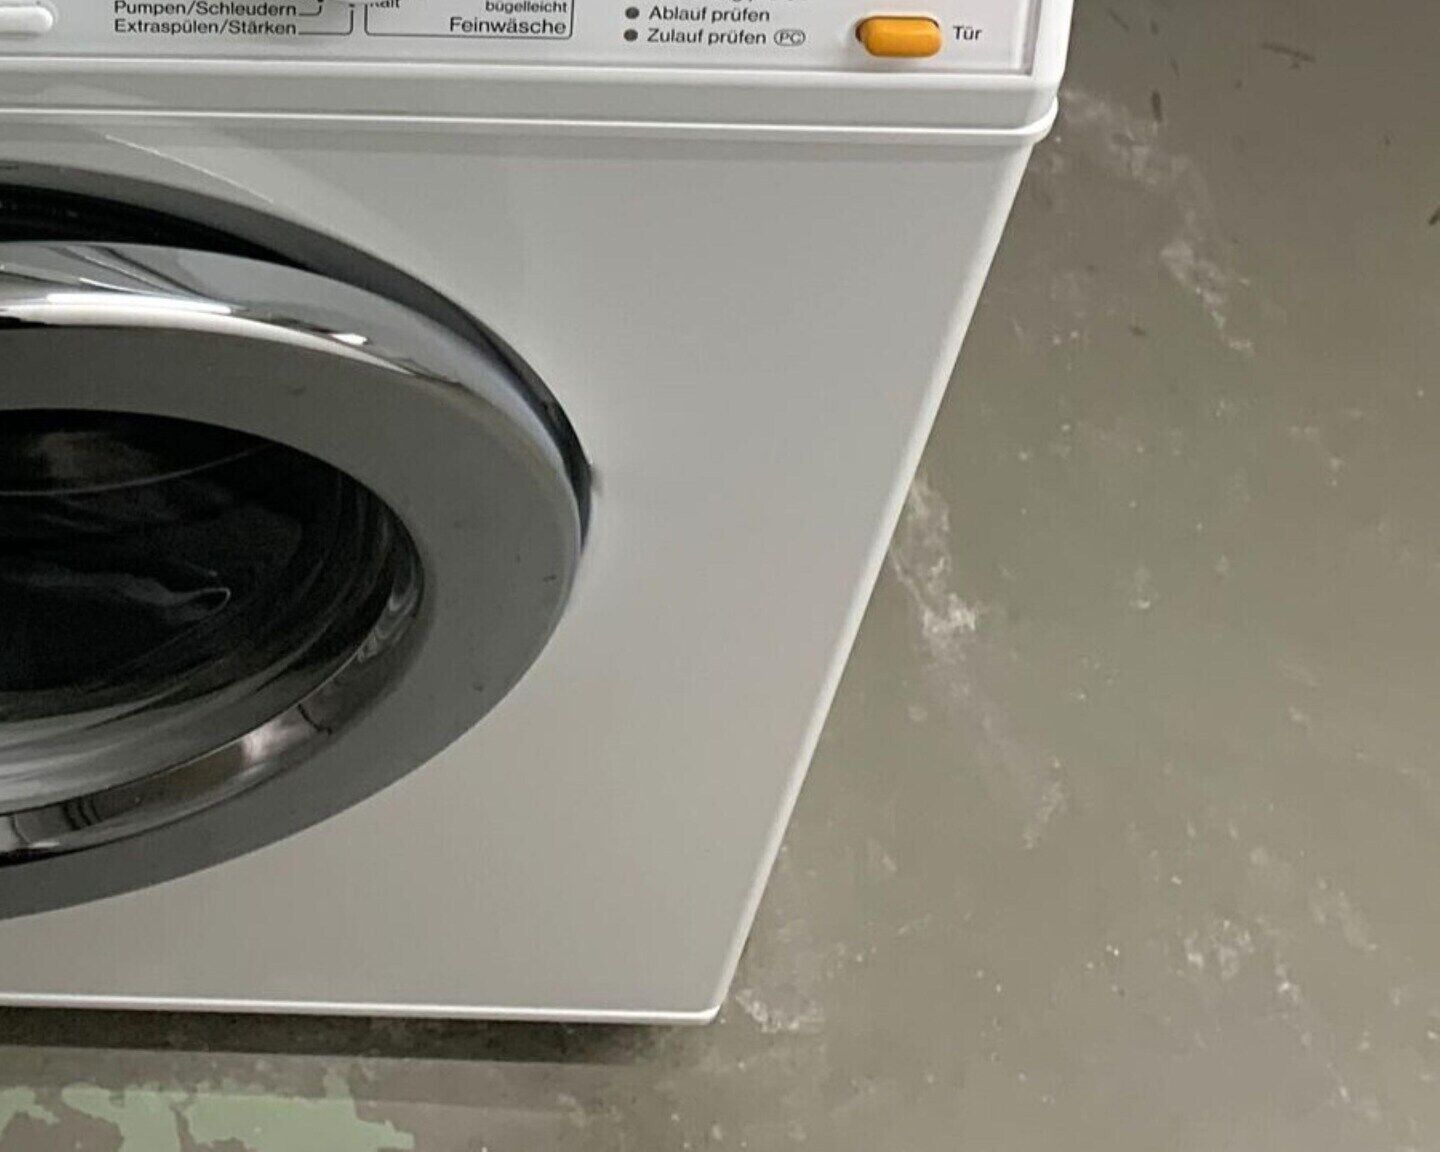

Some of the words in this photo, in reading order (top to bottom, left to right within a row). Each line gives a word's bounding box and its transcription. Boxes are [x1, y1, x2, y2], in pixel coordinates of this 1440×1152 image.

[648, 5, 708, 22] Ablauf
[711, 6, 771, 24] prüfen
[113, 18, 297, 37] Extraspülen/Stärken
[448, 16, 567, 35] Feinwäsche
[953, 26, 982, 42] Tür
[646, 27, 704, 45] Zulauf
[707, 29, 768, 48] prüfen
